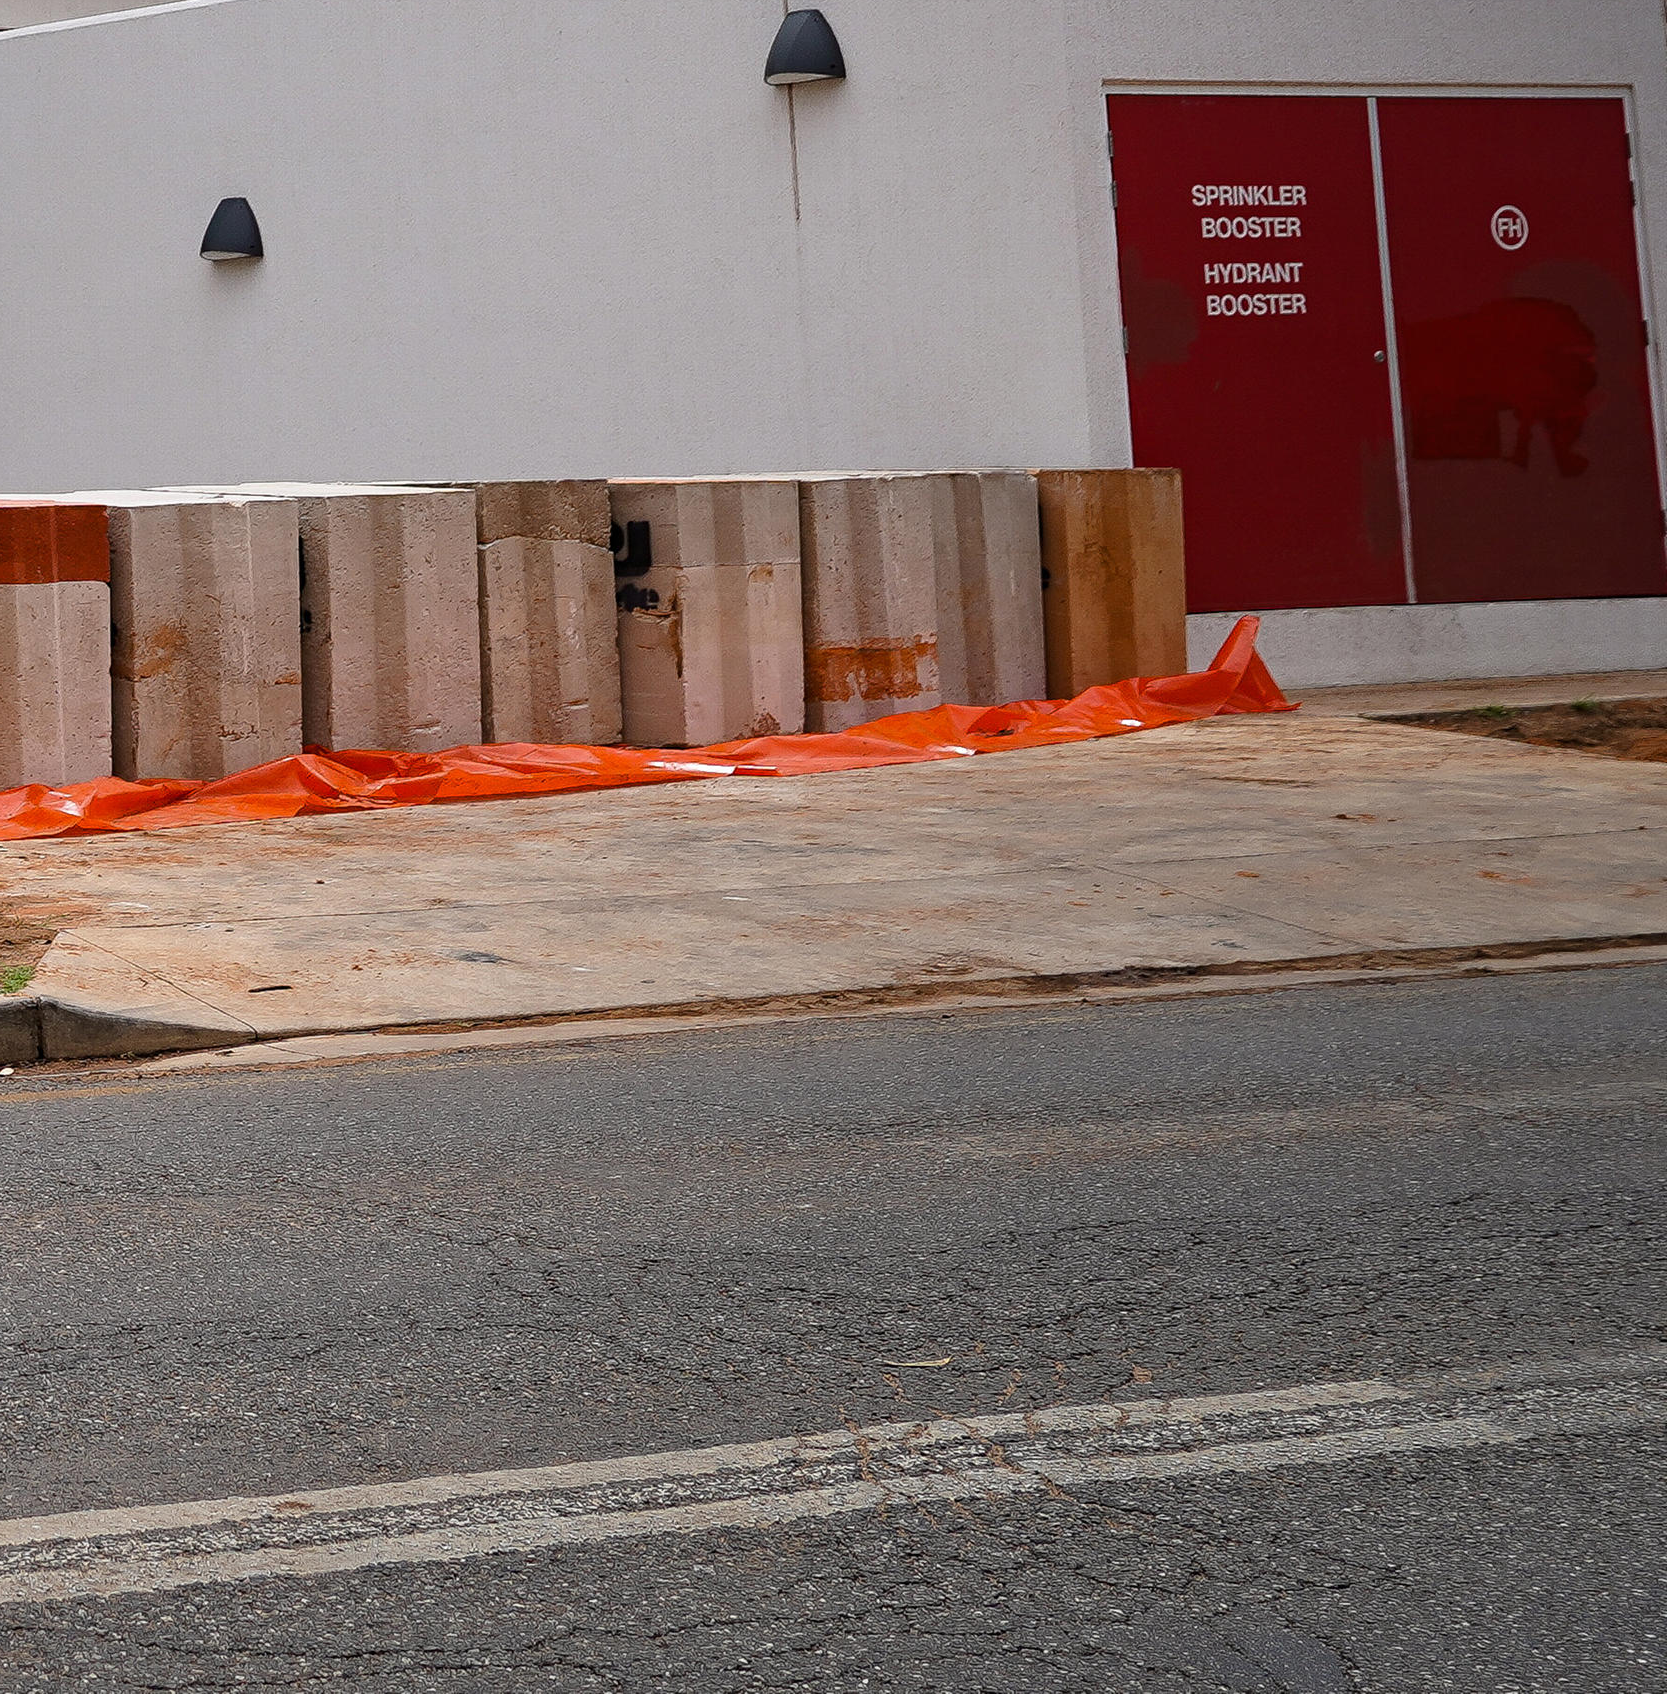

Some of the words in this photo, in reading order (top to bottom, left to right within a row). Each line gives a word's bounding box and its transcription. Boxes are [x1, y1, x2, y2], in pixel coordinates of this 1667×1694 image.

[1191, 185, 1307, 206] SPRINKLER
[1201, 216, 1301, 239] BOOSTER
[1498, 217, 1522, 238] FH
[1203, 262, 1303, 284] HYDRANT
[1207, 293, 1307, 316] BOOSTER
